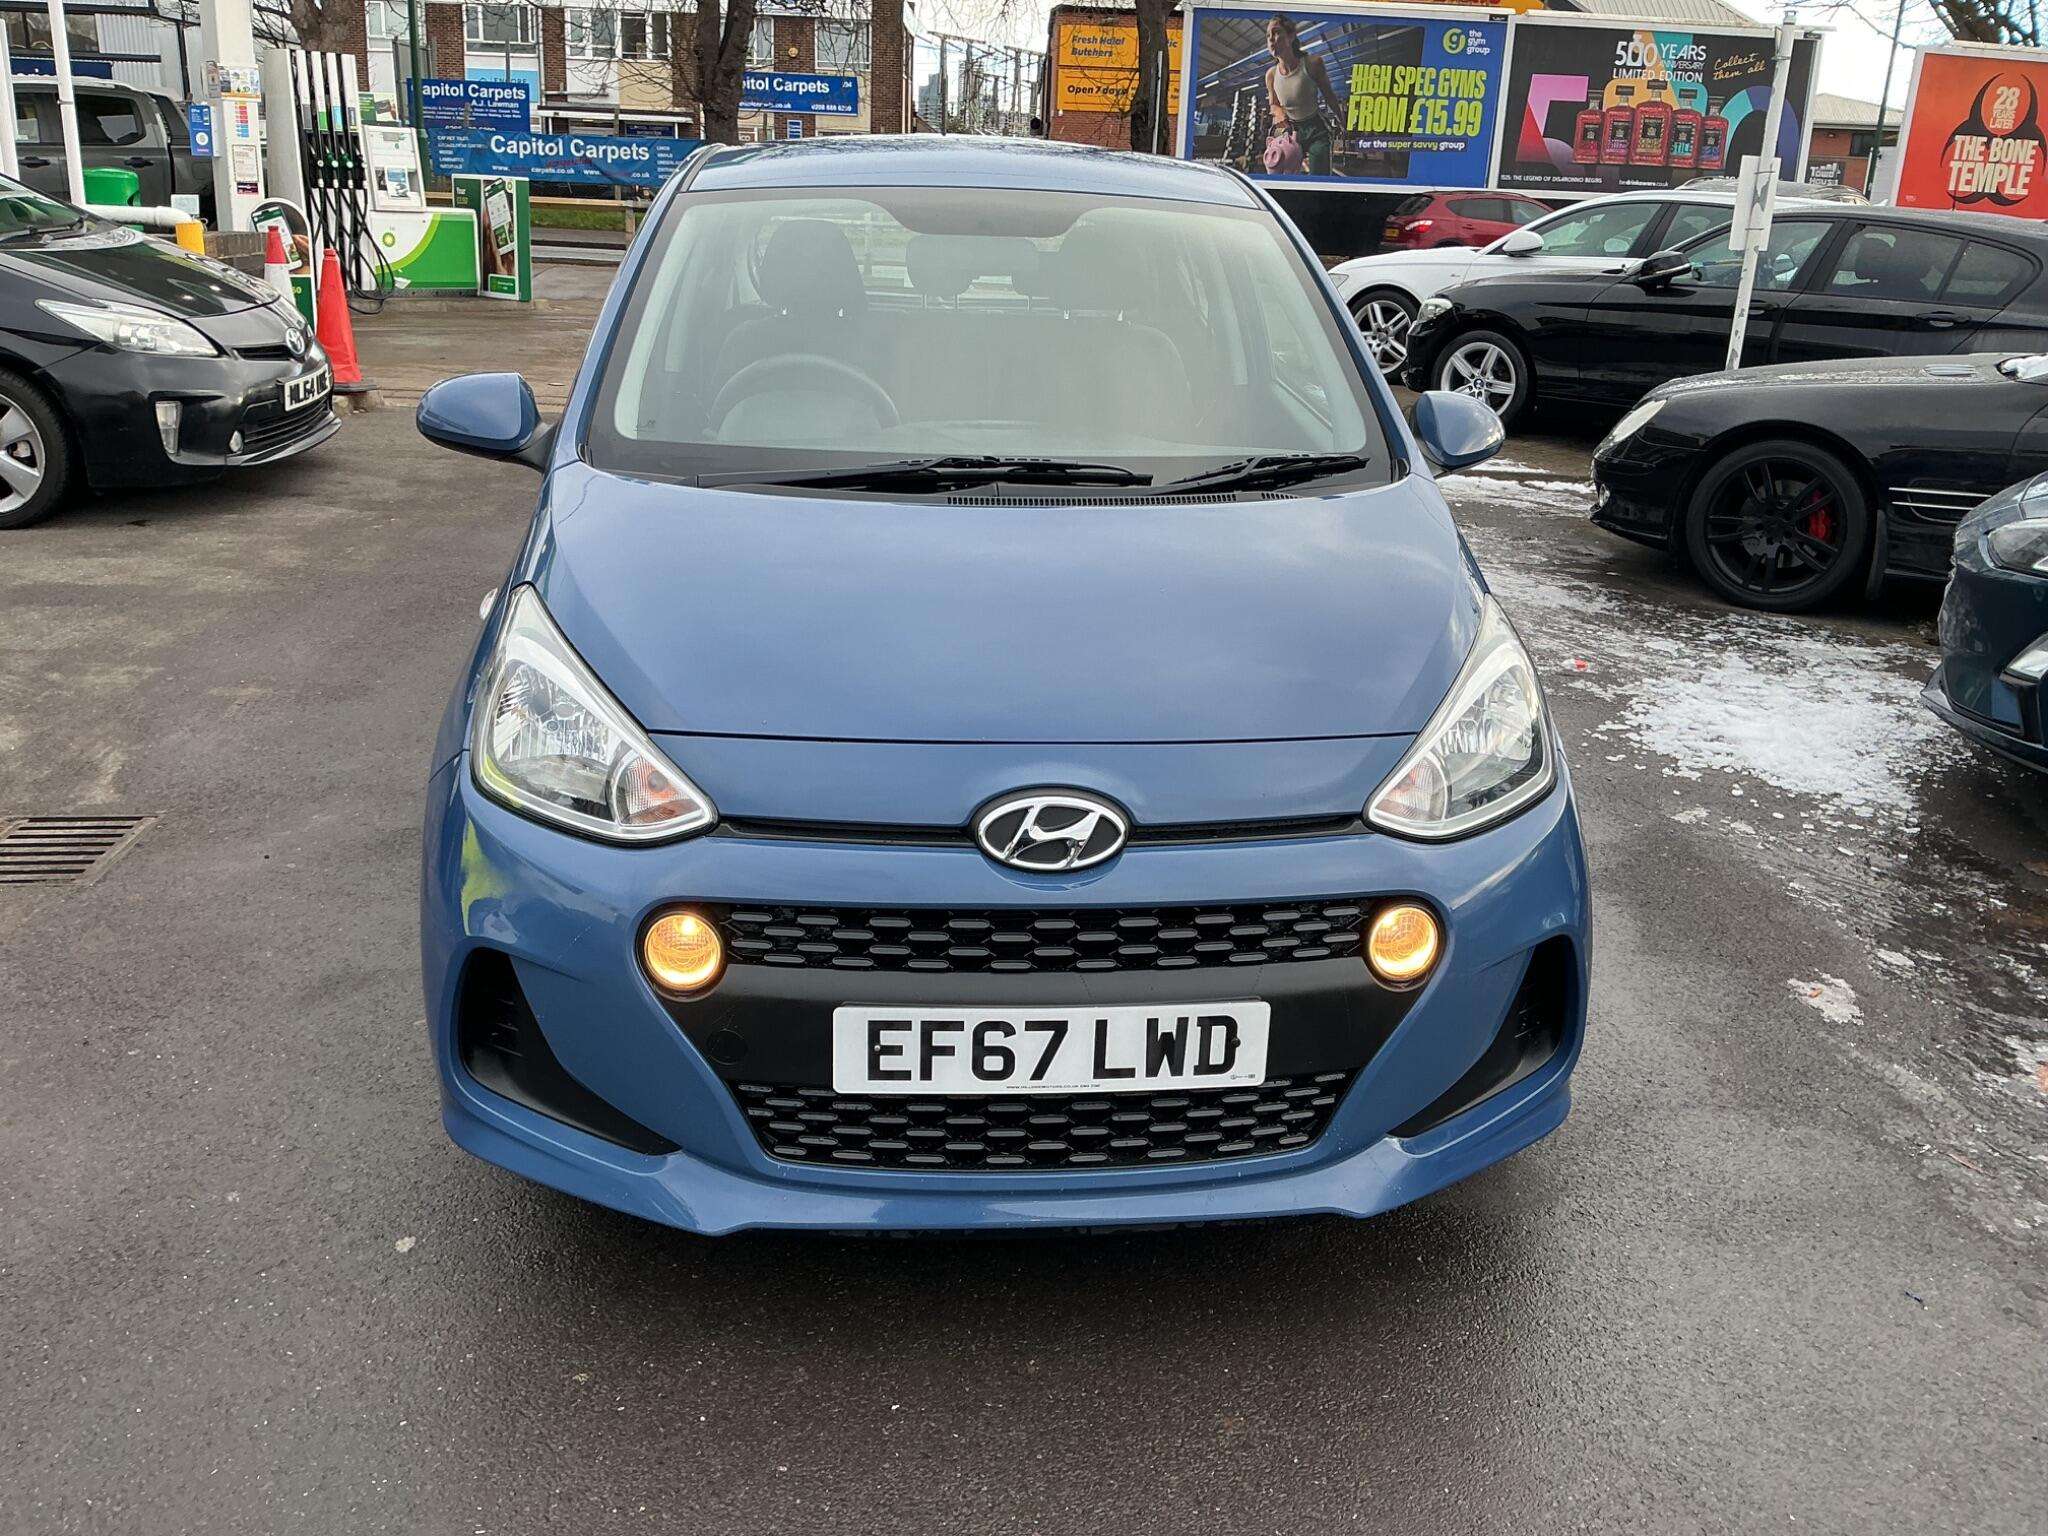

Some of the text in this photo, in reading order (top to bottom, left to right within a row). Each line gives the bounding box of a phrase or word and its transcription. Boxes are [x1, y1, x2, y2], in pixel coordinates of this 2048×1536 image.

[1071, 35, 1097, 45] Fresh
[1467, 37, 1486, 46] gym
[1469, 29, 1482, 38] the
[1466, 46, 1490, 55] group
[1660, 43, 1707, 61] YEARS
[1712, 60, 1766, 80] them all
[1714, 52, 1759, 70] Collect
[1351, 63, 1487, 99] HIGH SPEC GYMS
[1612, 67, 1704, 83] LIMITED EDITION
[411, 82, 526, 101] apitol Carpets
[742, 76, 769, 90] itol
[772, 78, 830, 96] Carpets
[1067, 84, 1094, 95] Open
[1095, 85, 1102, 94] 7
[1992, 86, 2021, 110] 28
[1346, 95, 1483, 137] FROM £15.99
[1989, 118, 2015, 130] LATER
[490, 134, 650, 163] Capitol Carpets
[1358, 139, 1466, 151] for the super savvy group
[1952, 134, 2040, 165] THE BONE
[1947, 160, 2034, 196] TEMPLE
[866, 1014, 1241, 1082] EF67 LWD
